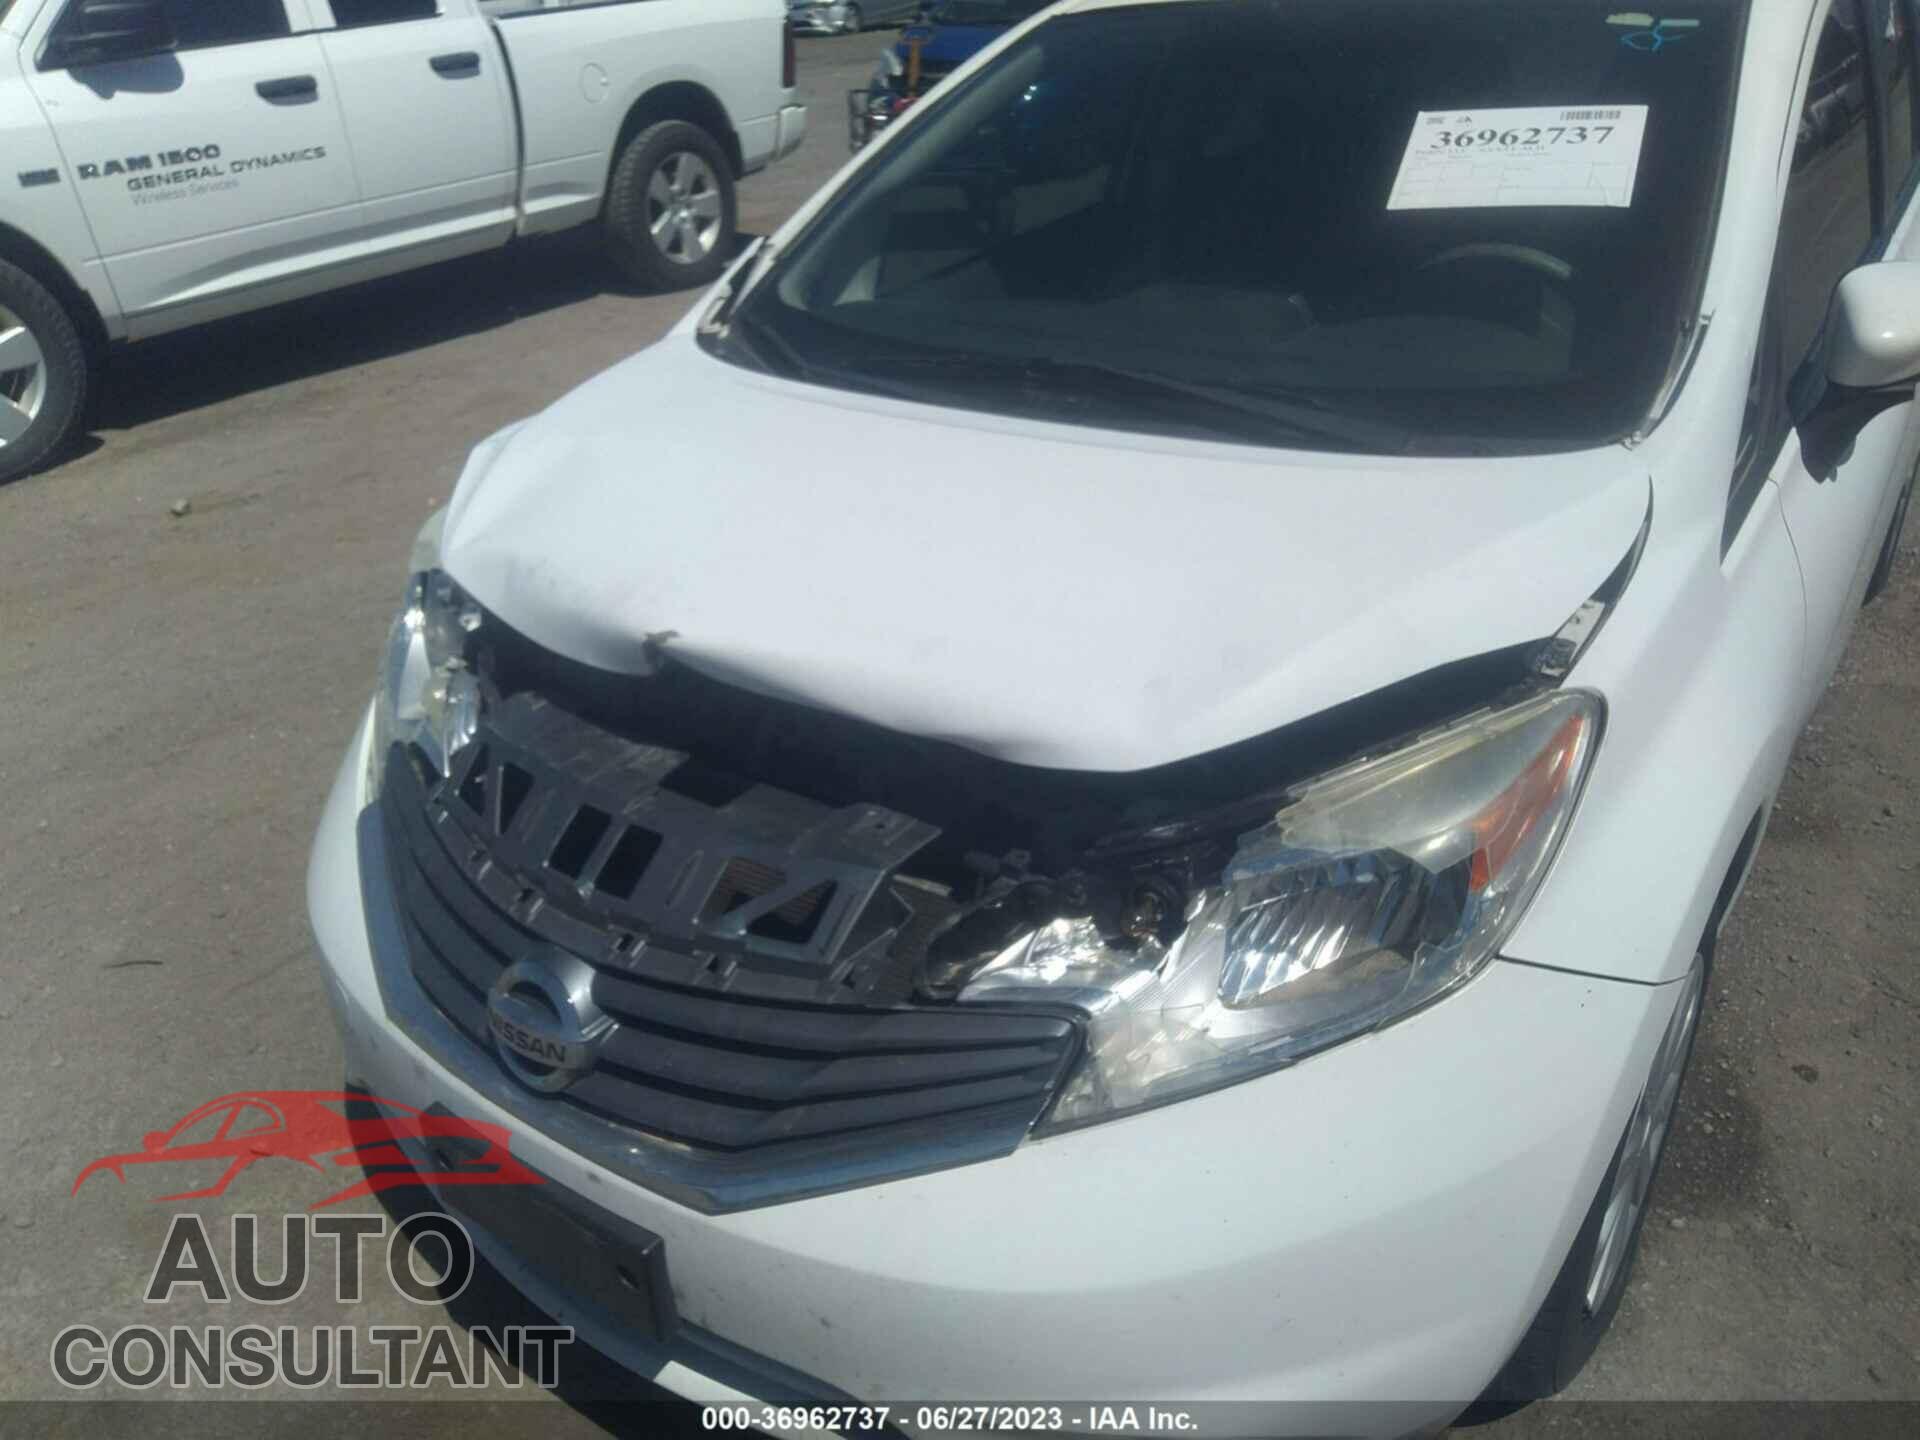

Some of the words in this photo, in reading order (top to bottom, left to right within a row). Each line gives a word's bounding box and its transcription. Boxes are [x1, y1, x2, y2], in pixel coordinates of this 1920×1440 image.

[1430, 125, 1616, 150] 36962737
[77, 155, 152, 180] RAM
[157, 144, 220, 167] 1500
[127, 165, 224, 192] GENERAL
[230, 146, 327, 173] DYNAMICS
[496, 1017, 566, 1063] SSAN
